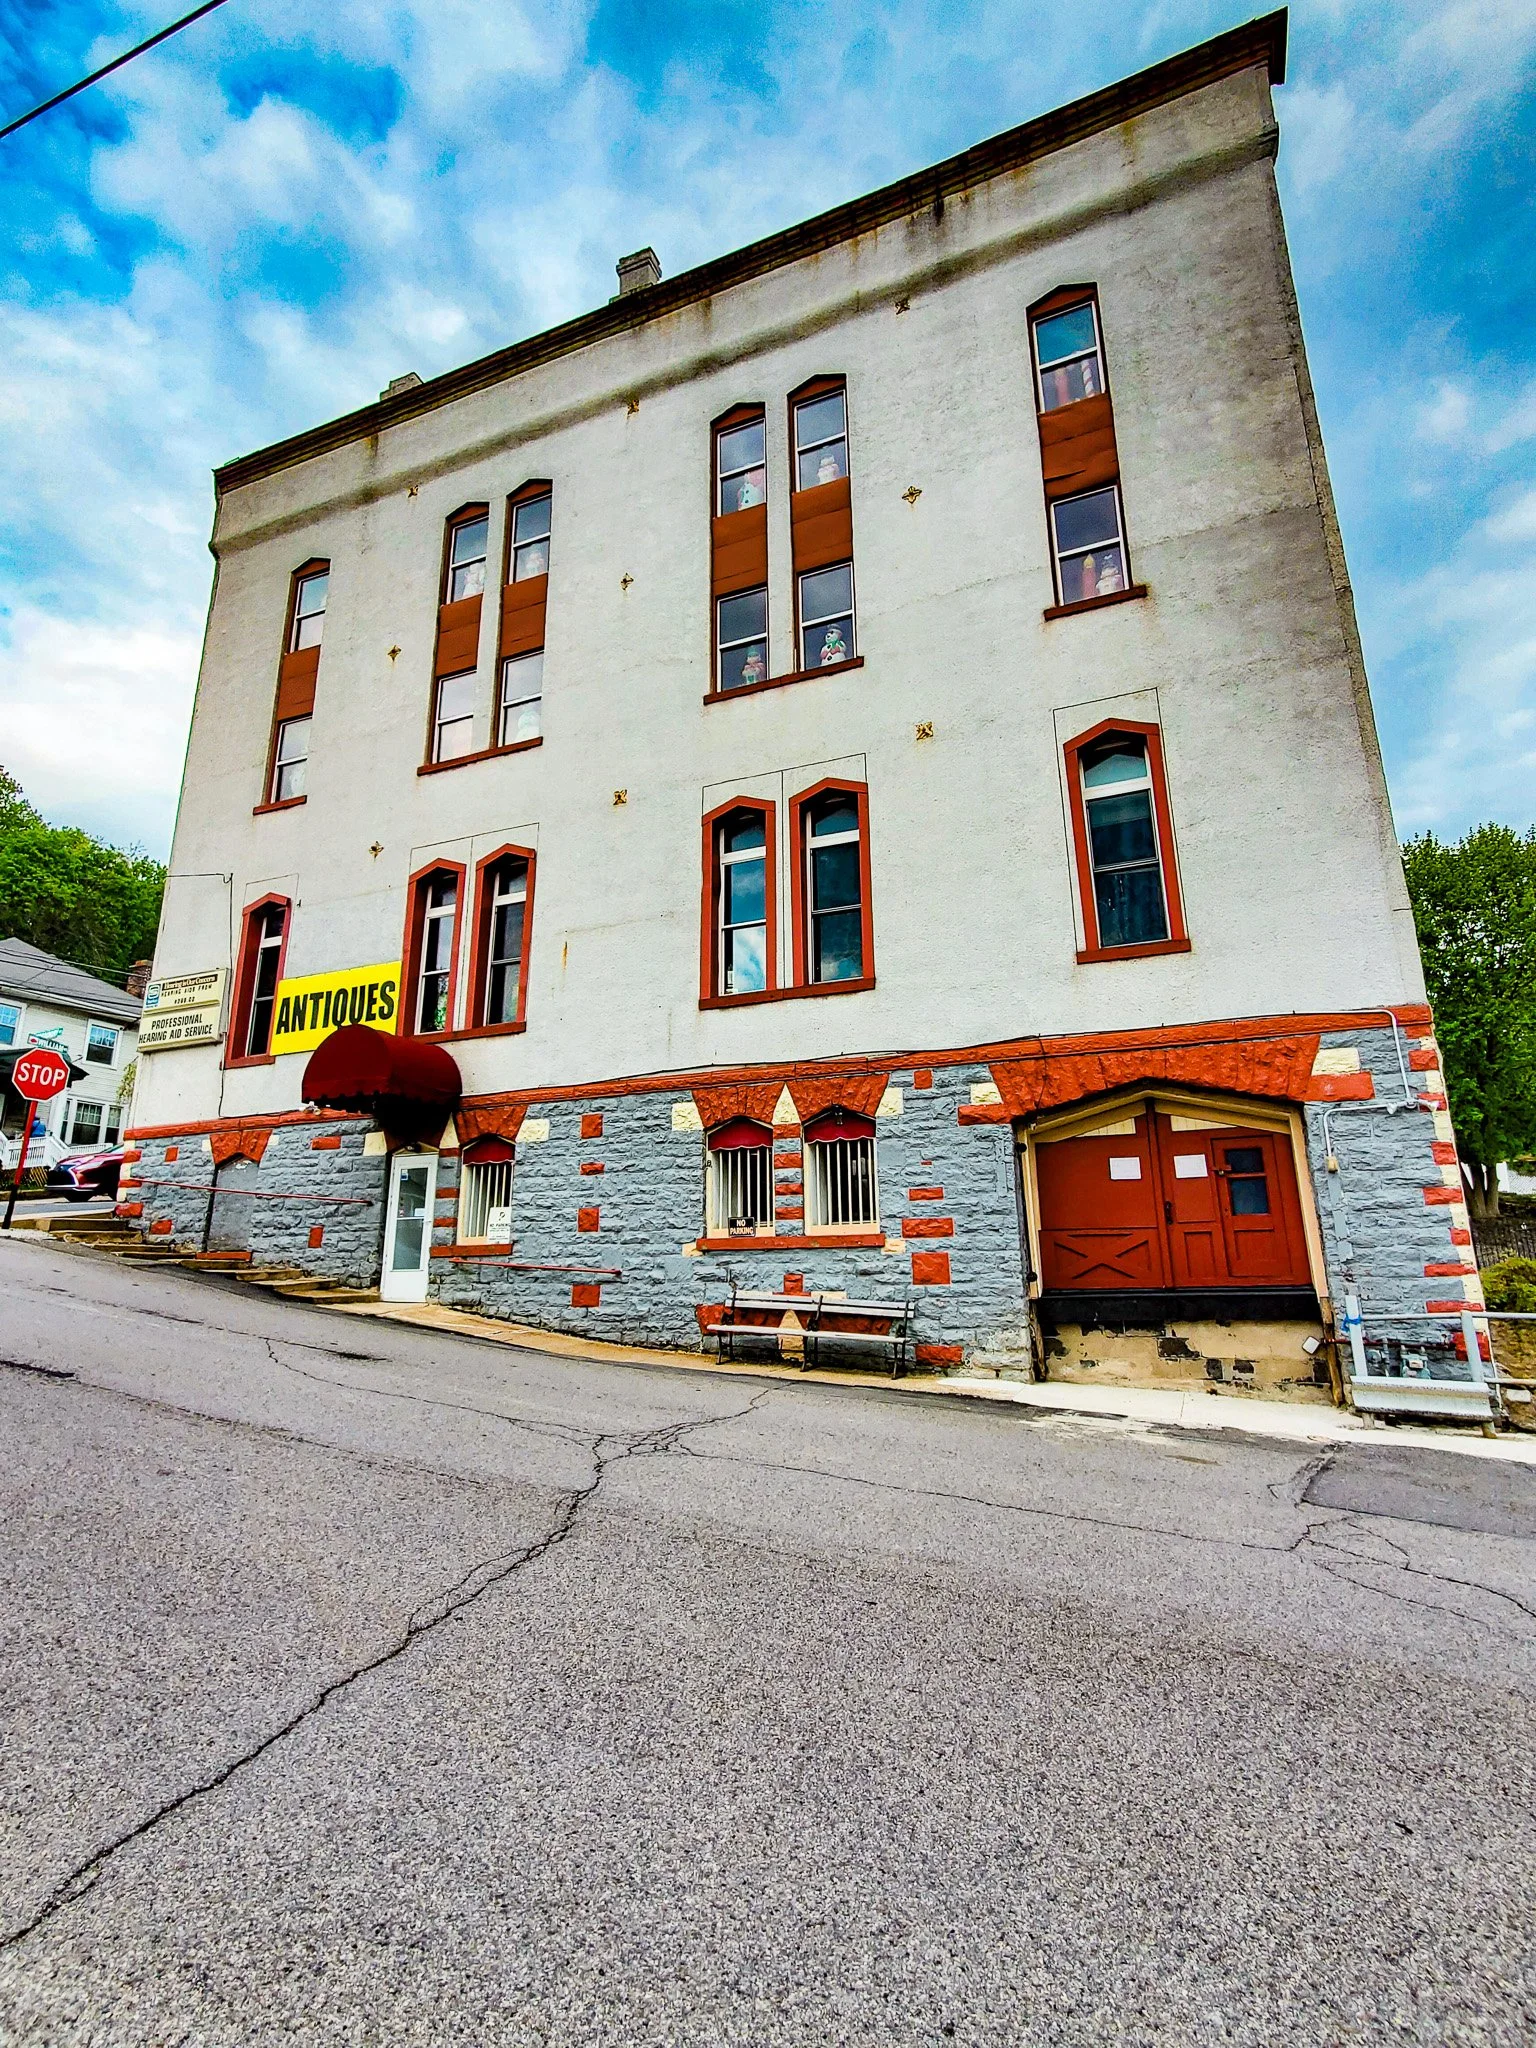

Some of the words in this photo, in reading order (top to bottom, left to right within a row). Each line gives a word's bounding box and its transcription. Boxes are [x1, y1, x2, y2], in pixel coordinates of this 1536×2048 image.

[276, 980, 396, 1035] ANTIQUES
[151, 1013, 203, 1031] PROFESSIONAL
[138, 1031, 168, 1044] HEARING
[169, 1028, 182, 1040] AID
[184, 1023, 213, 1038] SERVICE
[17, 1062, 66, 1087] STOP
[730, 1227, 754, 1235] PARKING
